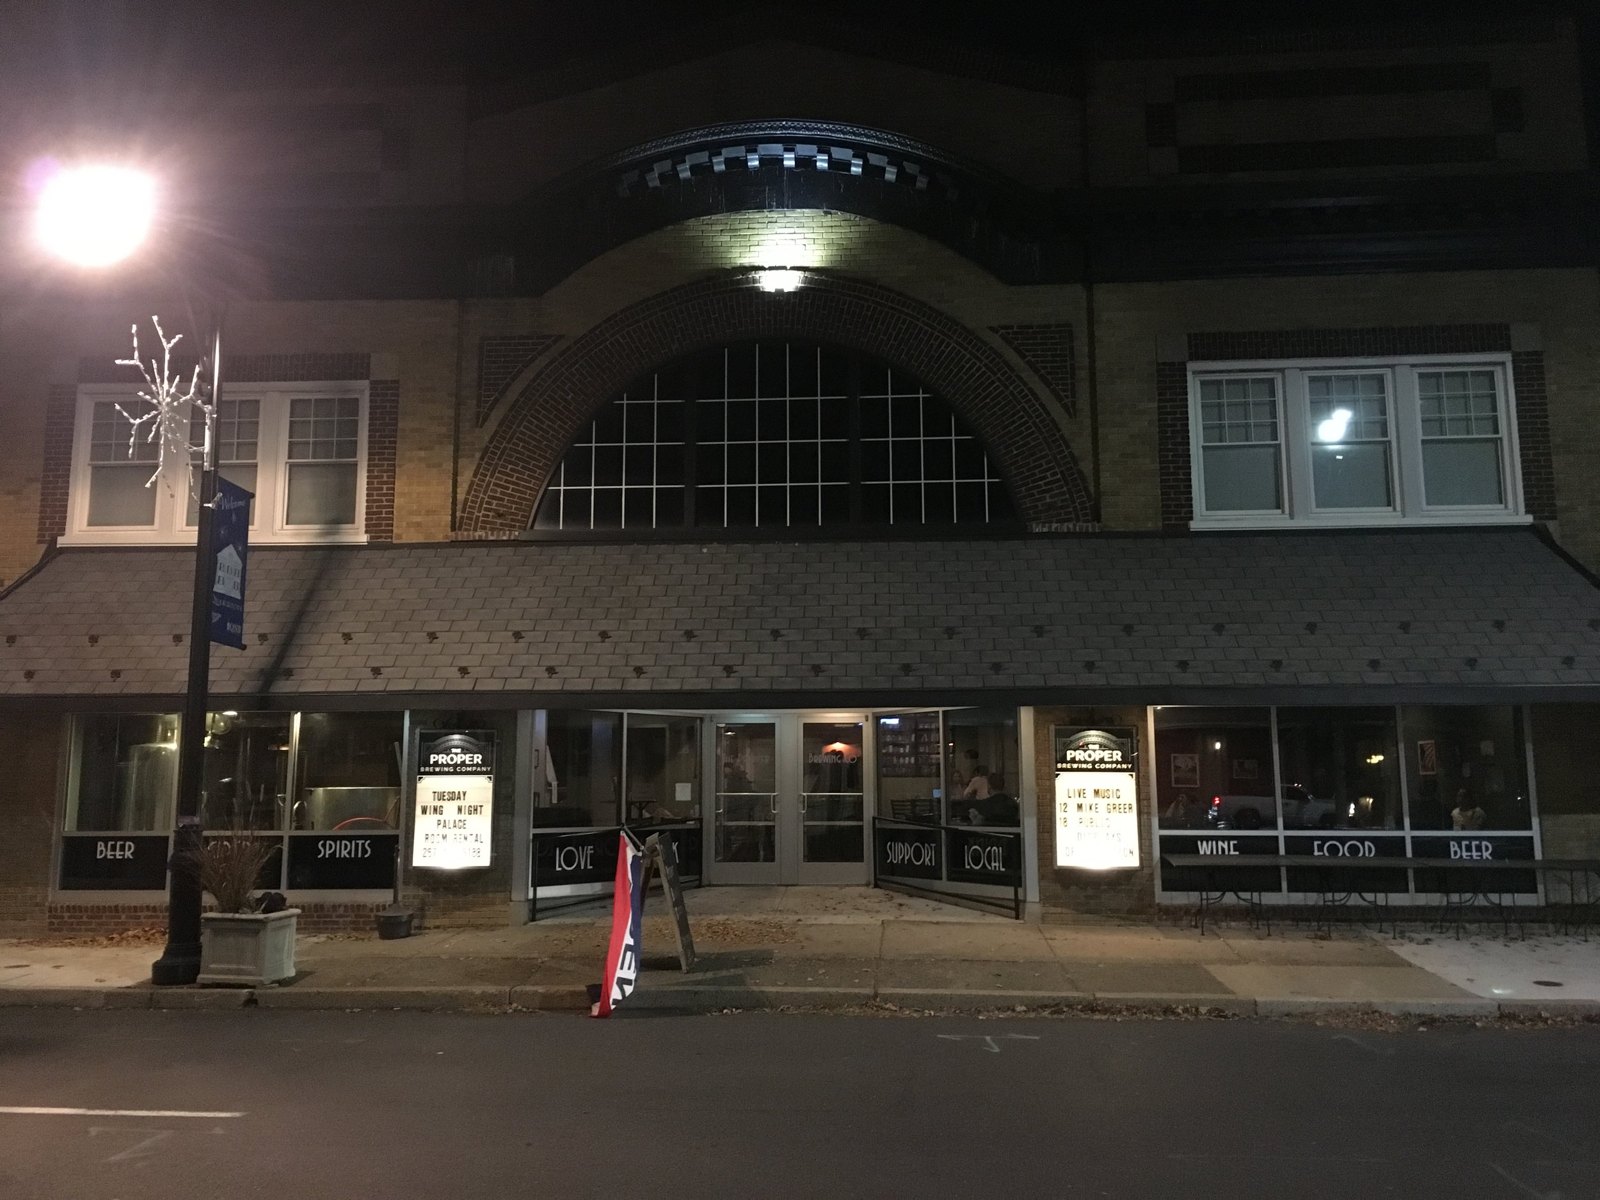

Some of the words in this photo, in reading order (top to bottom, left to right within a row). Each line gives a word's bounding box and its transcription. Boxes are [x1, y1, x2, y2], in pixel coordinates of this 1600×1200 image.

[429, 754, 482, 765] PROPER
[1066, 750, 1122, 762] PROPER
[432, 791, 467, 801] TUESDAY
[1067, 788, 1087, 799] LIVE
[1093, 788, 1121, 799] MUSIC
[420, 805, 444, 816] WING
[457, 805, 484, 816] NIGHT
[1059, 803, 1068, 813] 12
[1076, 803, 1099, 813] MIKE
[1106, 803, 1133, 814] GREER
[436, 819, 467, 830] PALACE
[96, 841, 135, 859] BEER
[317, 839, 371, 859] SPIRITS
[886, 841, 936, 867] SUPPORT
[1197, 839, 1239, 855] WINE
[1313, 840, 1376, 857] FOOD
[1449, 840, 1493, 860] BEER
[555, 845, 594, 871] LOVE
[964, 845, 1006, 872] LOCAL
